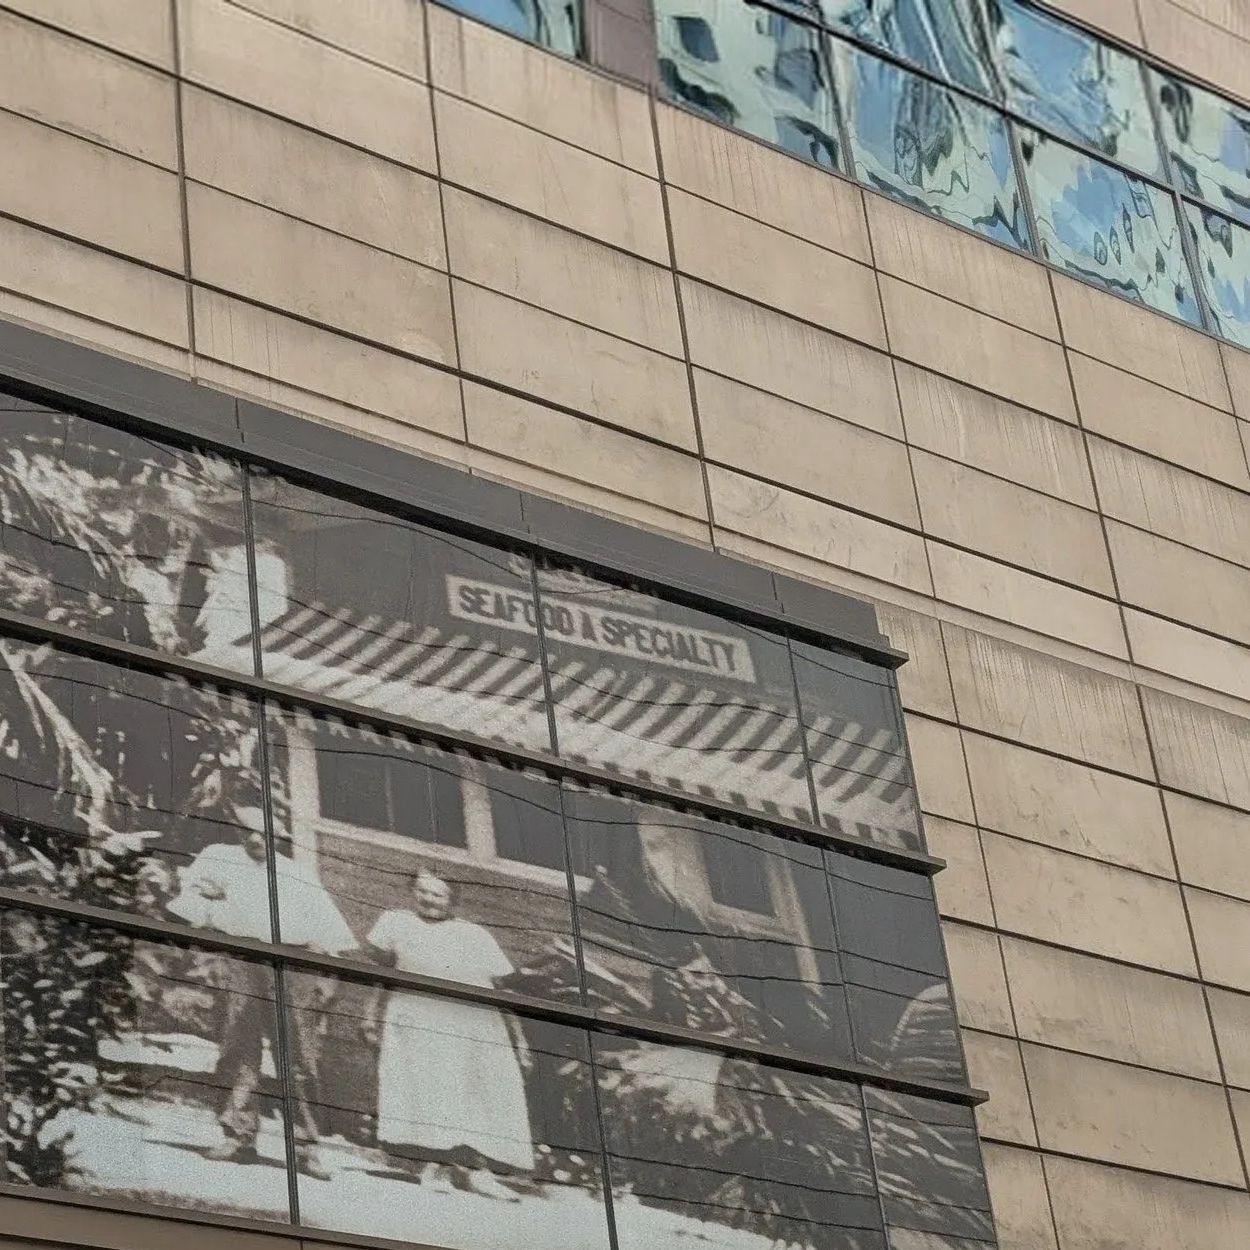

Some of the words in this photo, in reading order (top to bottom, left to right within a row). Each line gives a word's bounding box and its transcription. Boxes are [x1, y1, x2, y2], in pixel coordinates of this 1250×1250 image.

[459, 584, 574, 636] SEAFOOD
[580, 610, 598, 642] A
[601, 615, 736, 671] SPECIALTY
